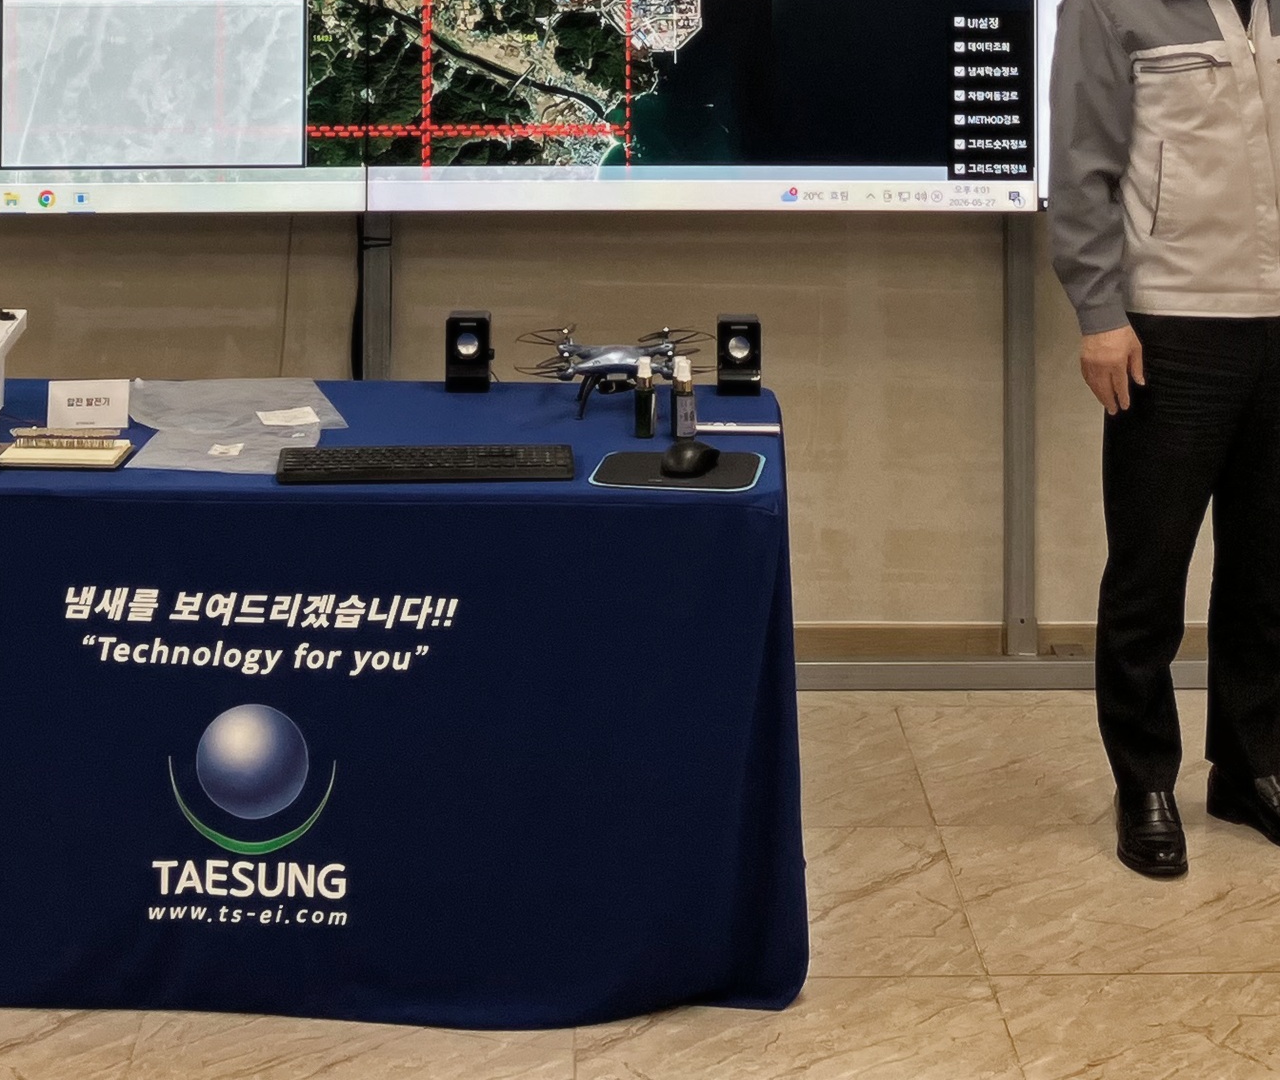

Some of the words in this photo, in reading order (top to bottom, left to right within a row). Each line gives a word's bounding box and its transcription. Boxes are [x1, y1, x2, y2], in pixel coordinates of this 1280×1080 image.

[967, 17, 999, 29] UI설정
[967, 42, 1011, 53] 데이터조회
[967, 66, 1019, 77] 냄새학습정보
[967, 114, 1020, 125] METHOD경로
[967, 139, 1028, 150] 그리드숫자정보
[85, 397, 111, 407] 발전기
[64, 585, 160, 622] 냄새를
[169, 591, 459, 630] 보여드리겠습니다!!
[81, 635, 284, 676] “Technology
[293, 642, 342, 672] for
[349, 645, 429, 677] you”
[151, 859, 347, 900] TAESUNG
[148, 904, 348, 926] www.ts-ei.com
